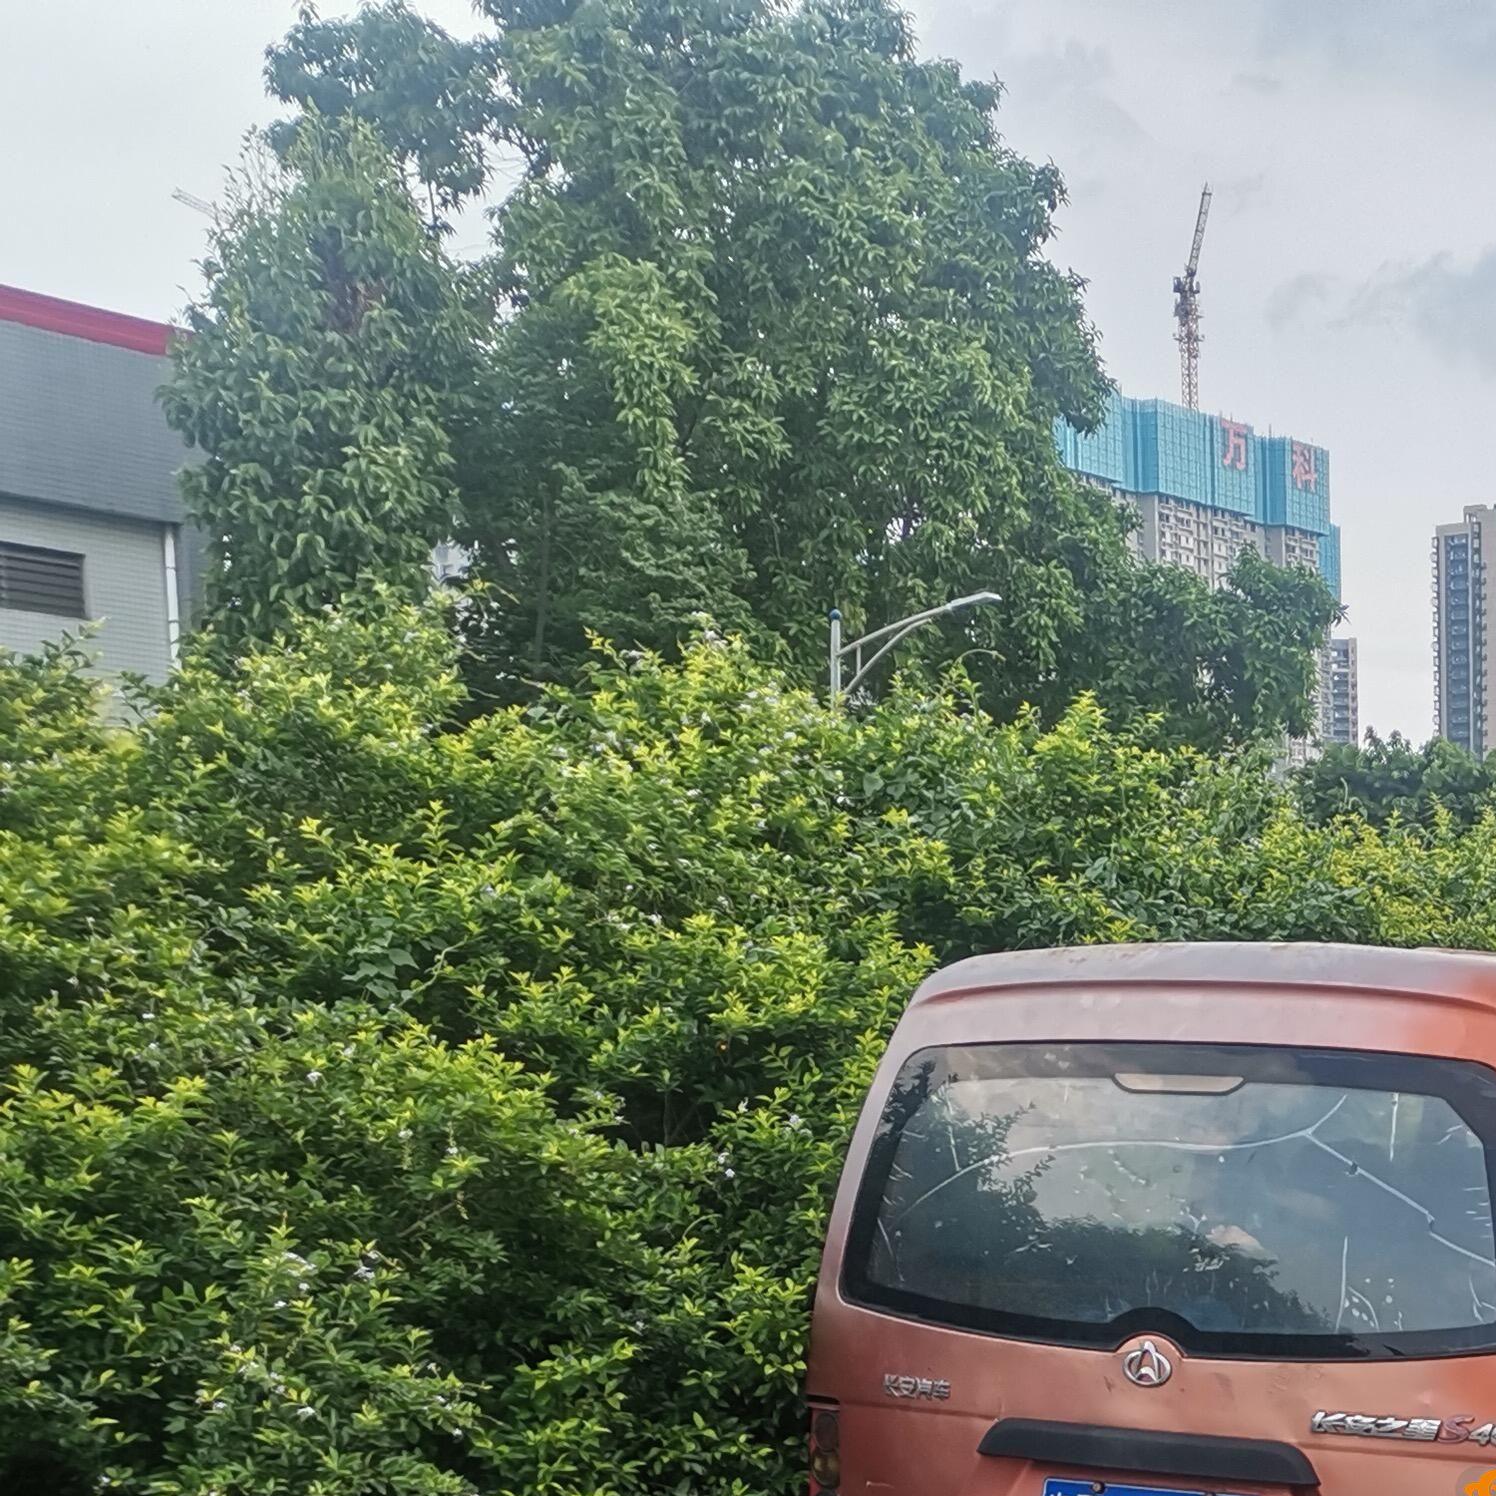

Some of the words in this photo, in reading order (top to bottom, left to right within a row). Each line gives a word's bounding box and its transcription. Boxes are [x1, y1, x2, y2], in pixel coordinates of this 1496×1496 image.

[1220, 418, 1317, 492] 万科
[883, 1374, 951, 1400] 长安汽车
